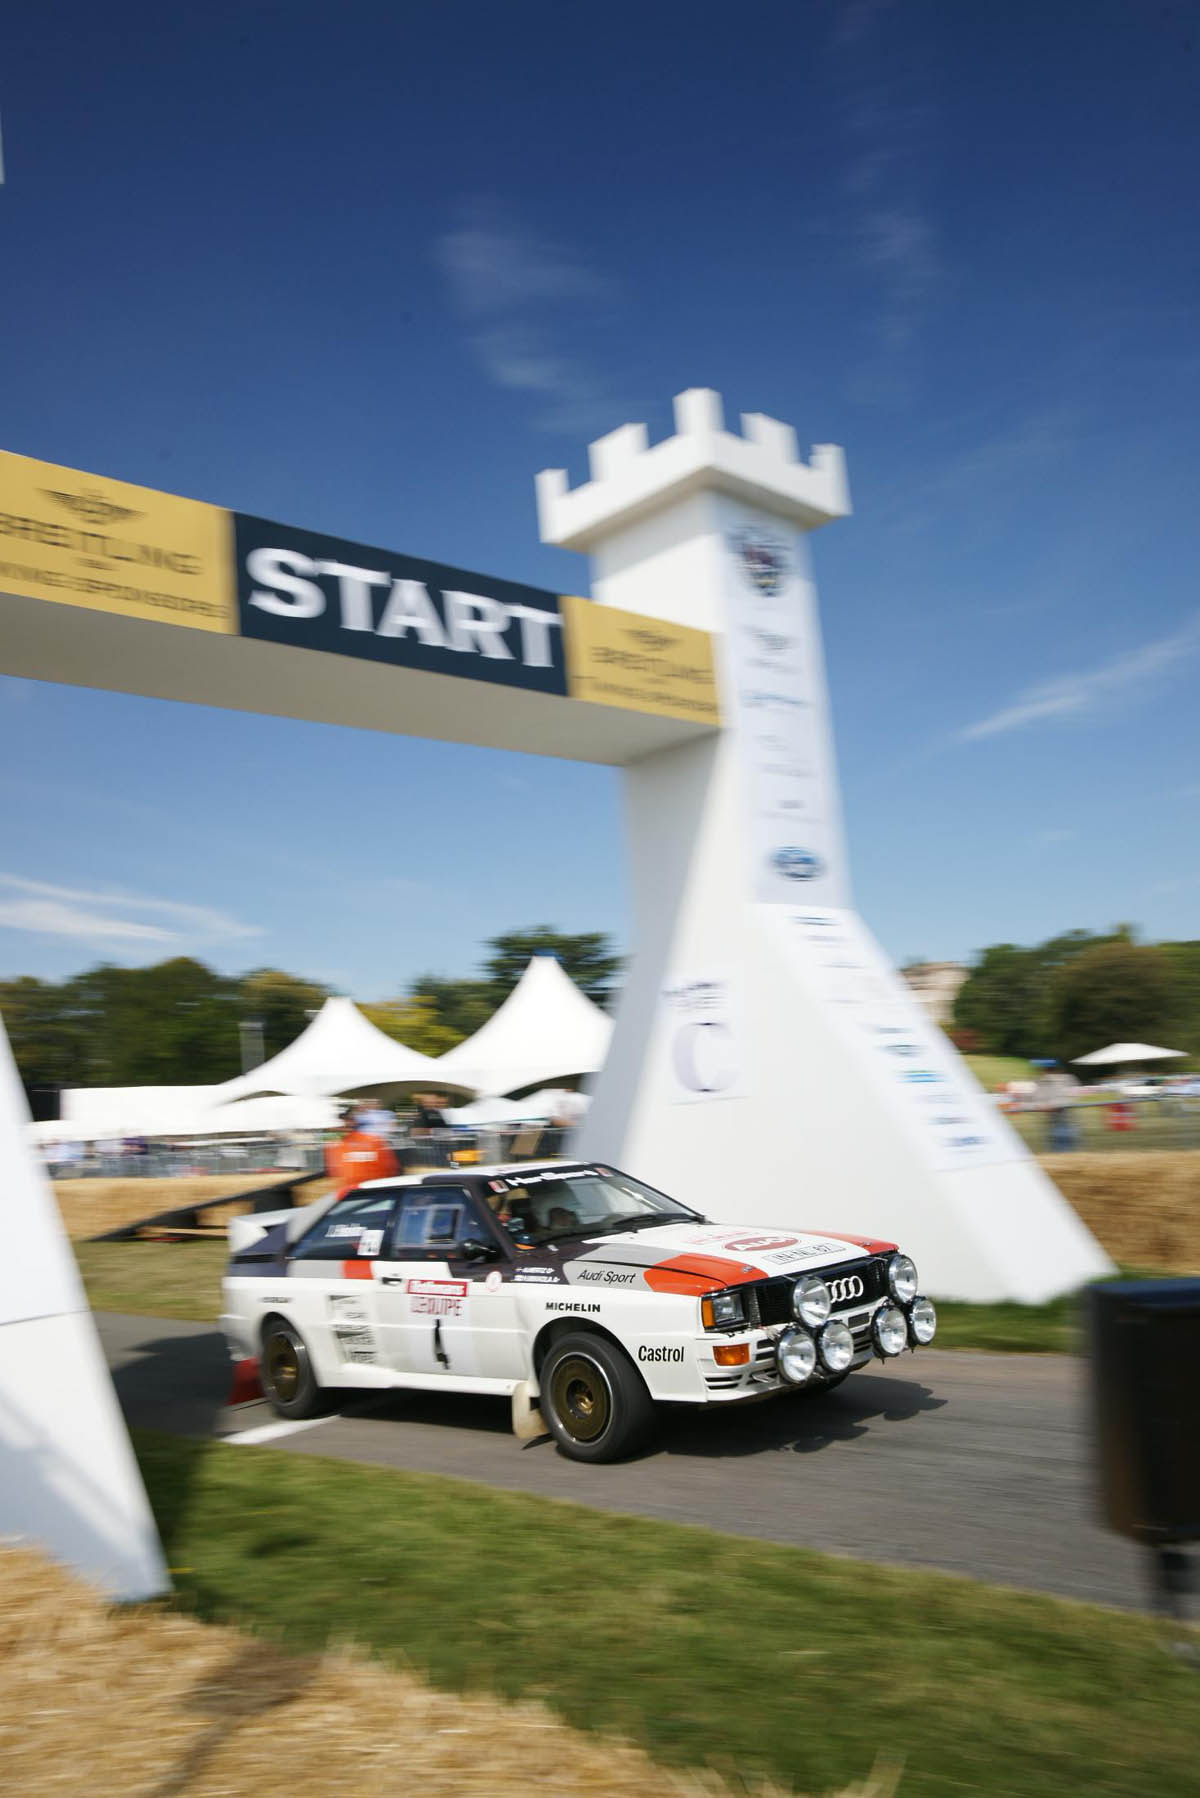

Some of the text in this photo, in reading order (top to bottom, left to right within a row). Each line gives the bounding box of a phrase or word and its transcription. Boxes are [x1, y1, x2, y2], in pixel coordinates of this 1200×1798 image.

[246, 546, 564, 668] START
[577, 1269, 636, 1284] Audi Sport
[546, 1302, 601, 1312] MICHELIN
[638, 1345, 685, 1362] Castrol
